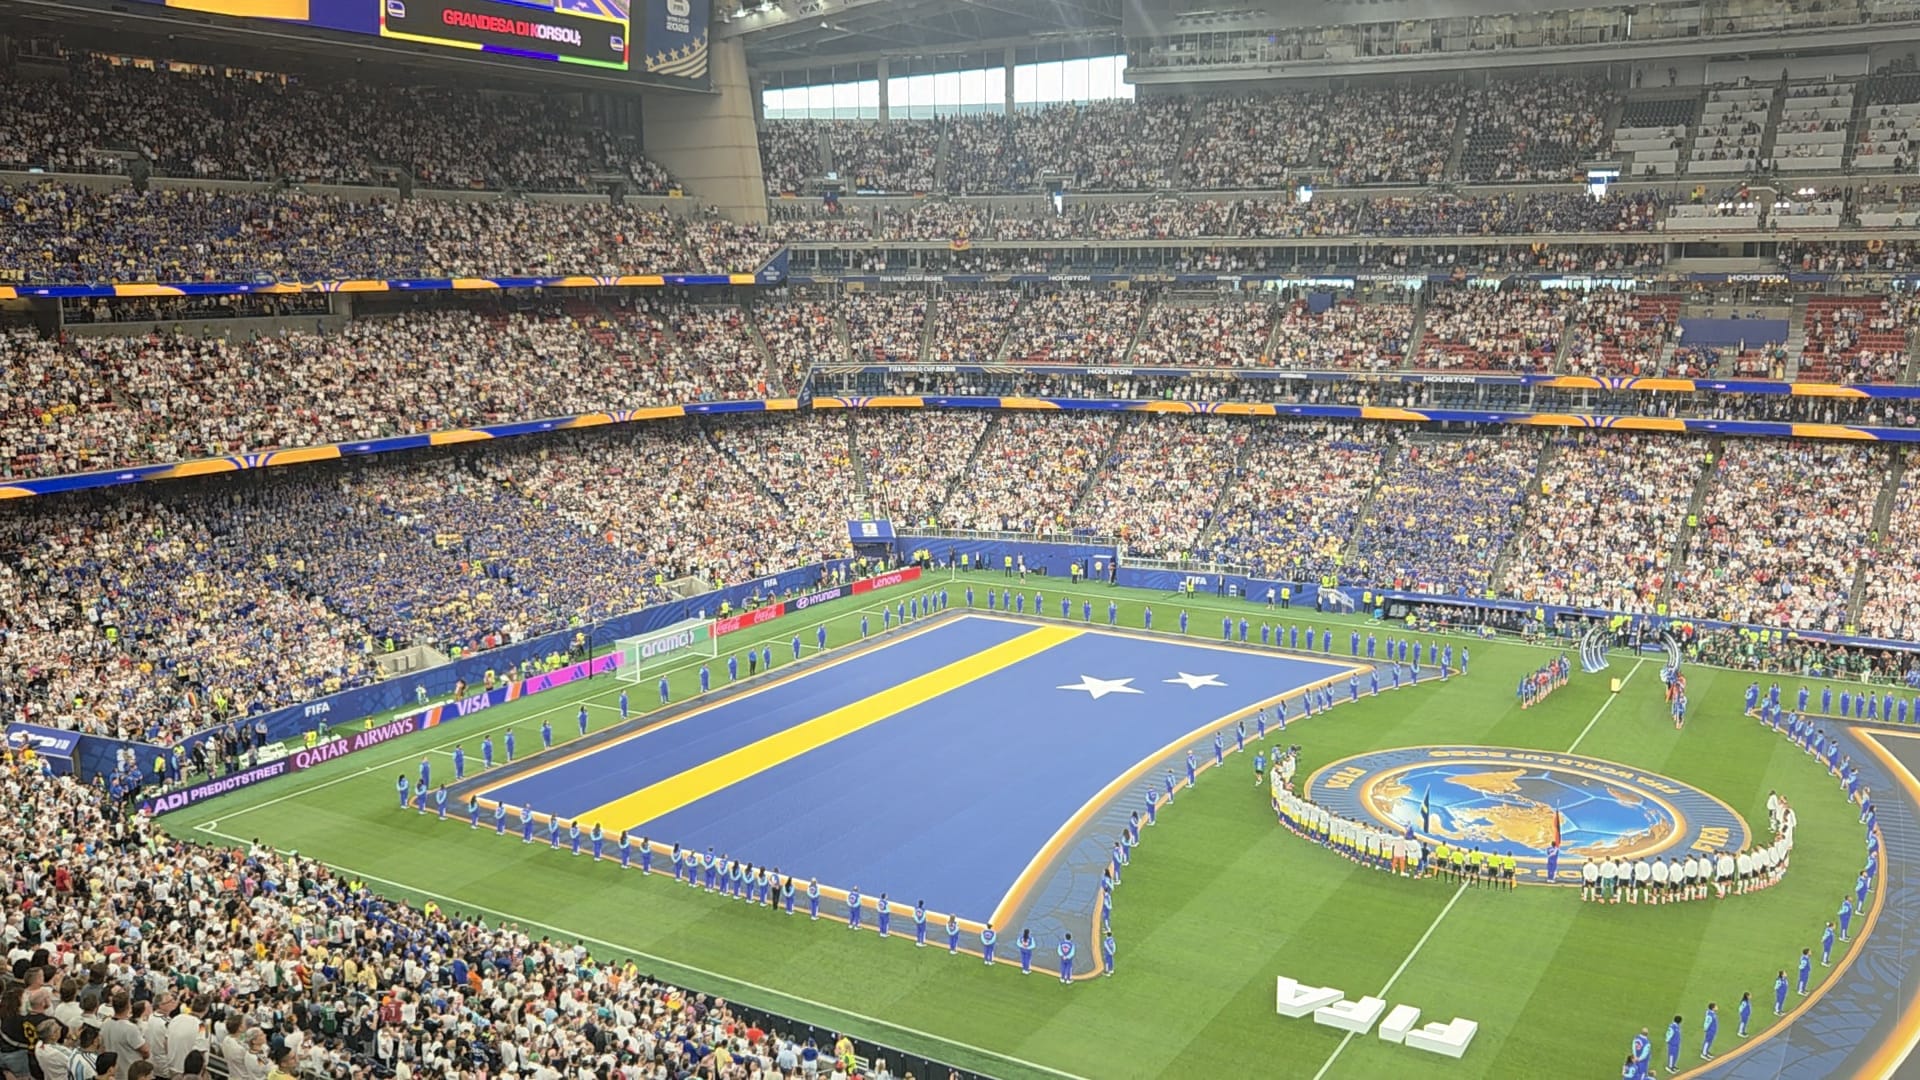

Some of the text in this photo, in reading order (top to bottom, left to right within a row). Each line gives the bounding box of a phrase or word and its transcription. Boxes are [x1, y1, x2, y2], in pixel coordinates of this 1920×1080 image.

[442, 9, 515, 34] GRANDESA
[516, 21, 529, 36] DI
[666, 22, 689, 33] 2026
[1423, 375, 1476, 383] HOUSTON
[763, 579, 777, 588] FIFA
[873, 574, 902, 589] Lenovo
[810, 589, 840, 605] HYUNDAI
[304, 702, 330, 717] FIFA
[455, 692, 490, 716] VISA
[296, 718, 413, 768] QATAR AIRWAYS
[1510, 753, 1554, 762] CUP
[1324, 766, 1367, 788] FIFA
[1558, 758, 1634, 779] WORLD
[153, 761, 285, 815] ADI PREDICTSTREET
[1691, 827, 1729, 853] FIFA
[1277, 975, 1478, 1058] FIFA
